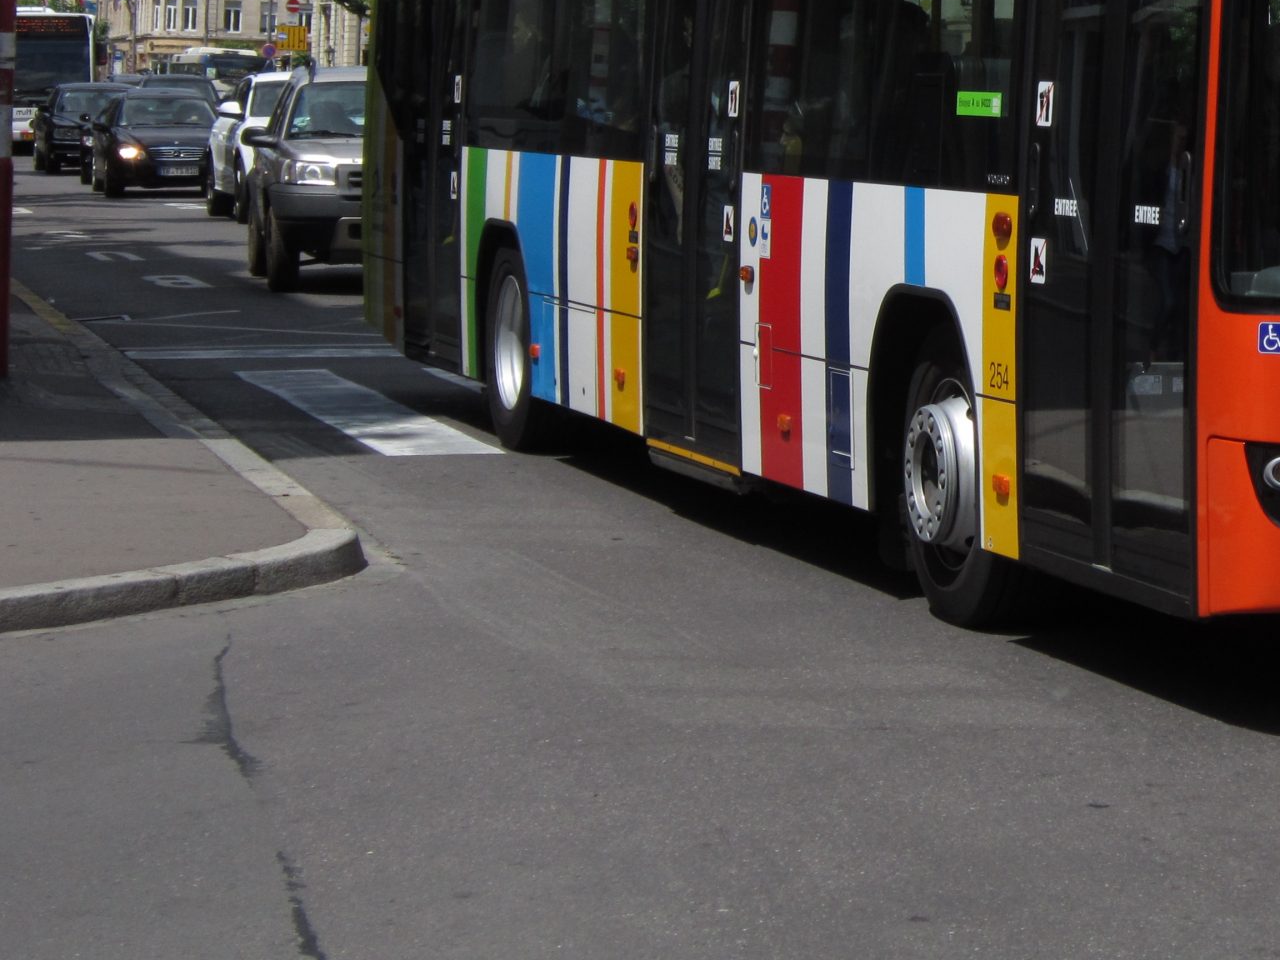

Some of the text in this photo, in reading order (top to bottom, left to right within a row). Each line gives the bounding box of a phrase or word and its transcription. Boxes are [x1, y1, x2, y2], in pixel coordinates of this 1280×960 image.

[1054, 198, 1077, 217] ENTREE
[1134, 205, 1160, 225] ENTREE
[989, 361, 1009, 391] 254
